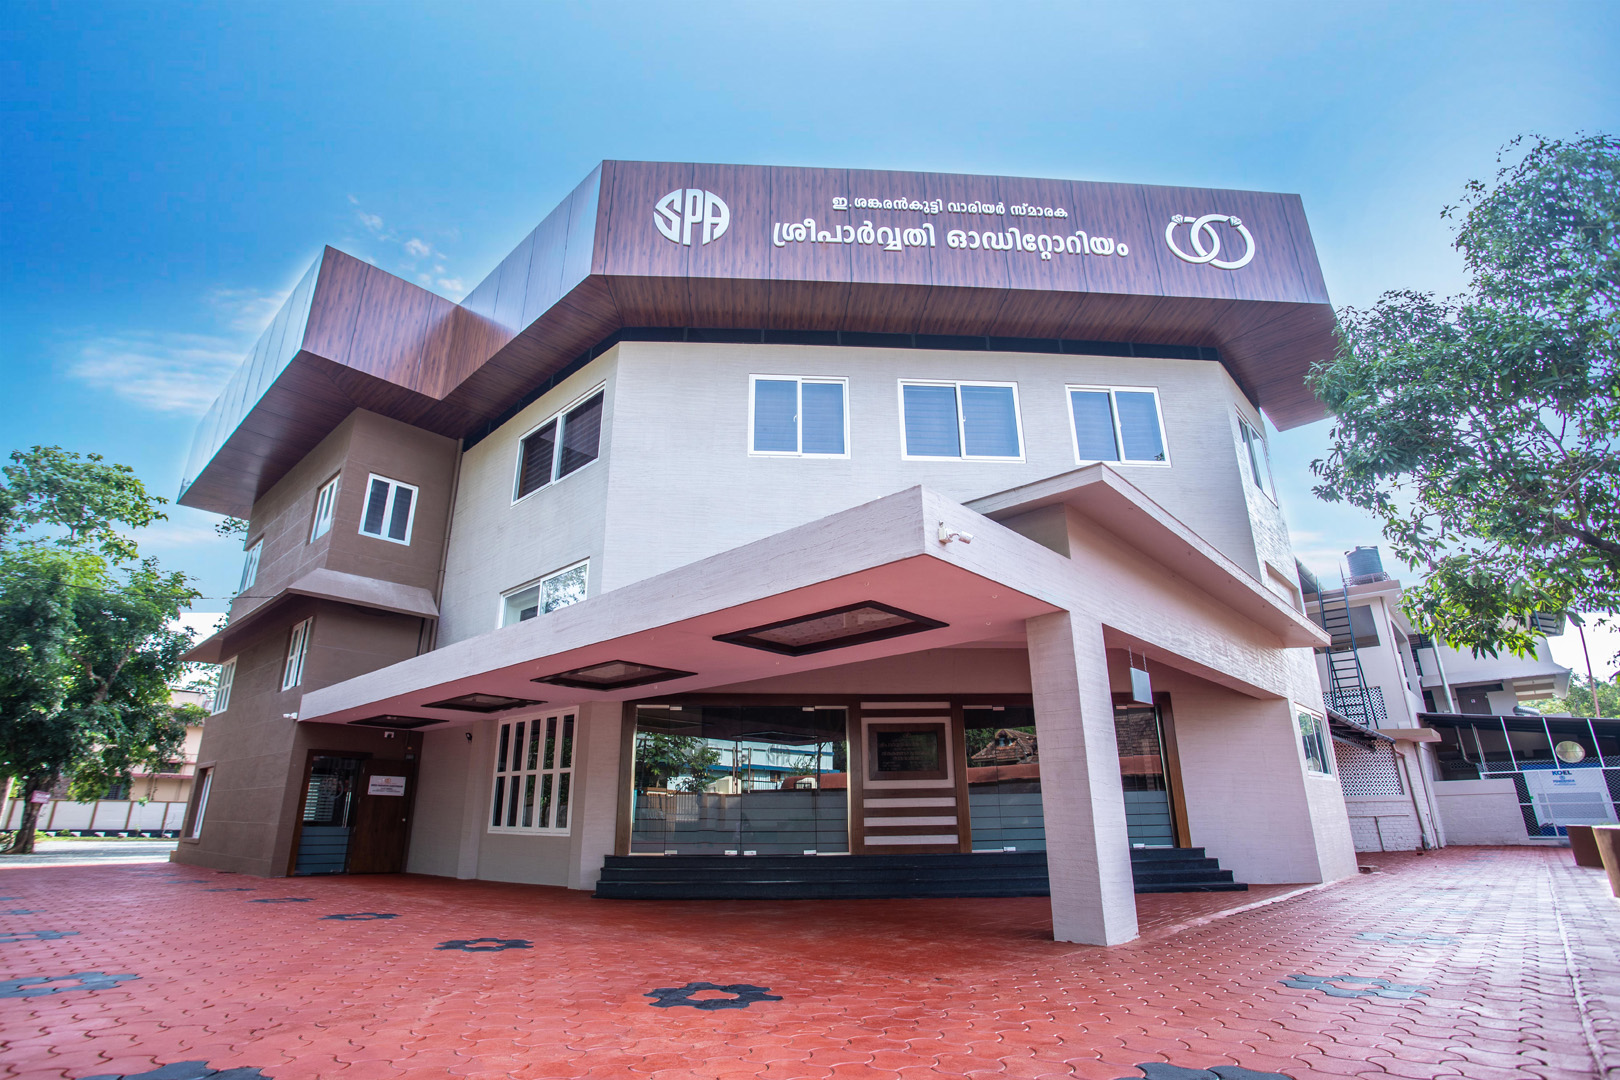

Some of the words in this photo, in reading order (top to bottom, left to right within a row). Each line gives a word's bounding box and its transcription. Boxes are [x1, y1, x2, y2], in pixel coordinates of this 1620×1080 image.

[653, 188, 730, 246] SPA
[947, 200, 1005, 216] വാരിയർ
[1010, 203, 1068, 218] സ്മാരക
[773, 218, 936, 251] ശ്രീപാർവ്വതി
[946, 227, 1129, 260] ഓഡിറ്റോറിയം
